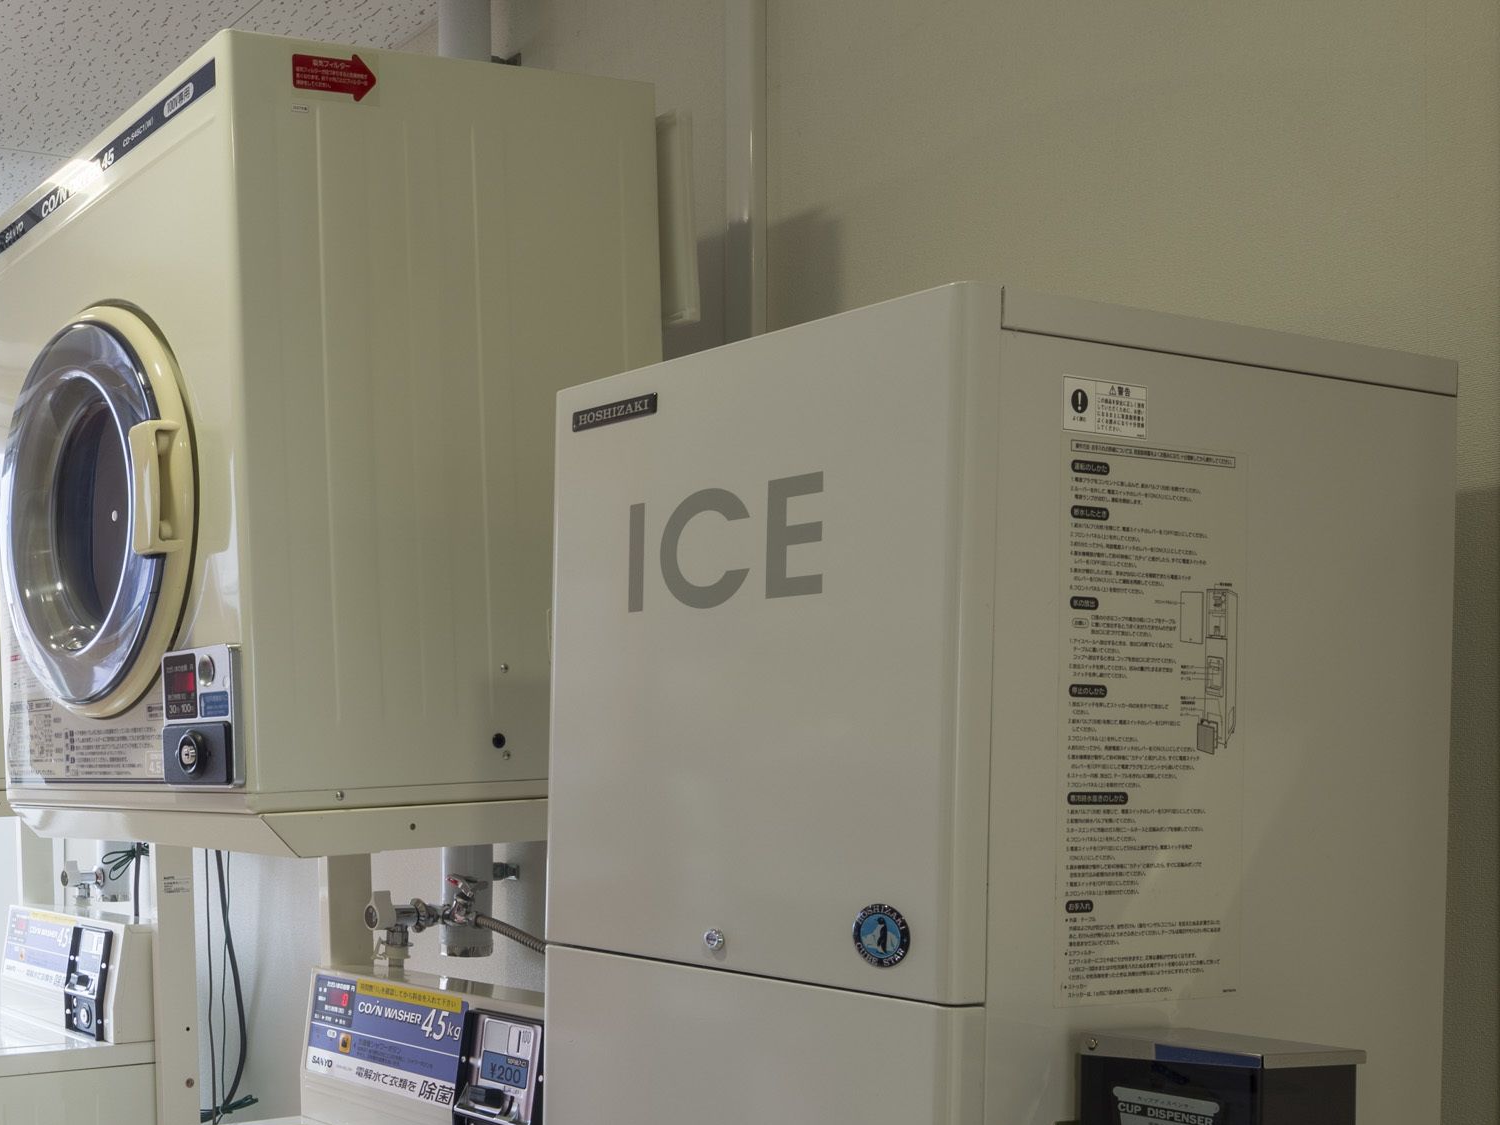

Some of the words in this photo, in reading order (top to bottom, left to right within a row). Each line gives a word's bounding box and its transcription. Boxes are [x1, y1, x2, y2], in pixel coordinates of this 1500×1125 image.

[5, 221, 24, 244] SANYO
[1117, 386, 1132, 398] 警告
[578, 399, 650, 426] HOSHIZAKI
[628, 471, 824, 613] ICE
[856, 904, 906, 930] HOSHIZAKI
[883, 948, 905, 966] STAR
[384, 1007, 422, 1025] WASHER
[447, 1021, 462, 1041] kg
[522, 1030, 532, 1044] 100
[311, 1055, 333, 1068] SANYO
[418, 1080, 455, 1105] 除菌
[490, 1062, 521, 1084] ¥200
[1117, 1101, 1142, 1115] CUP
